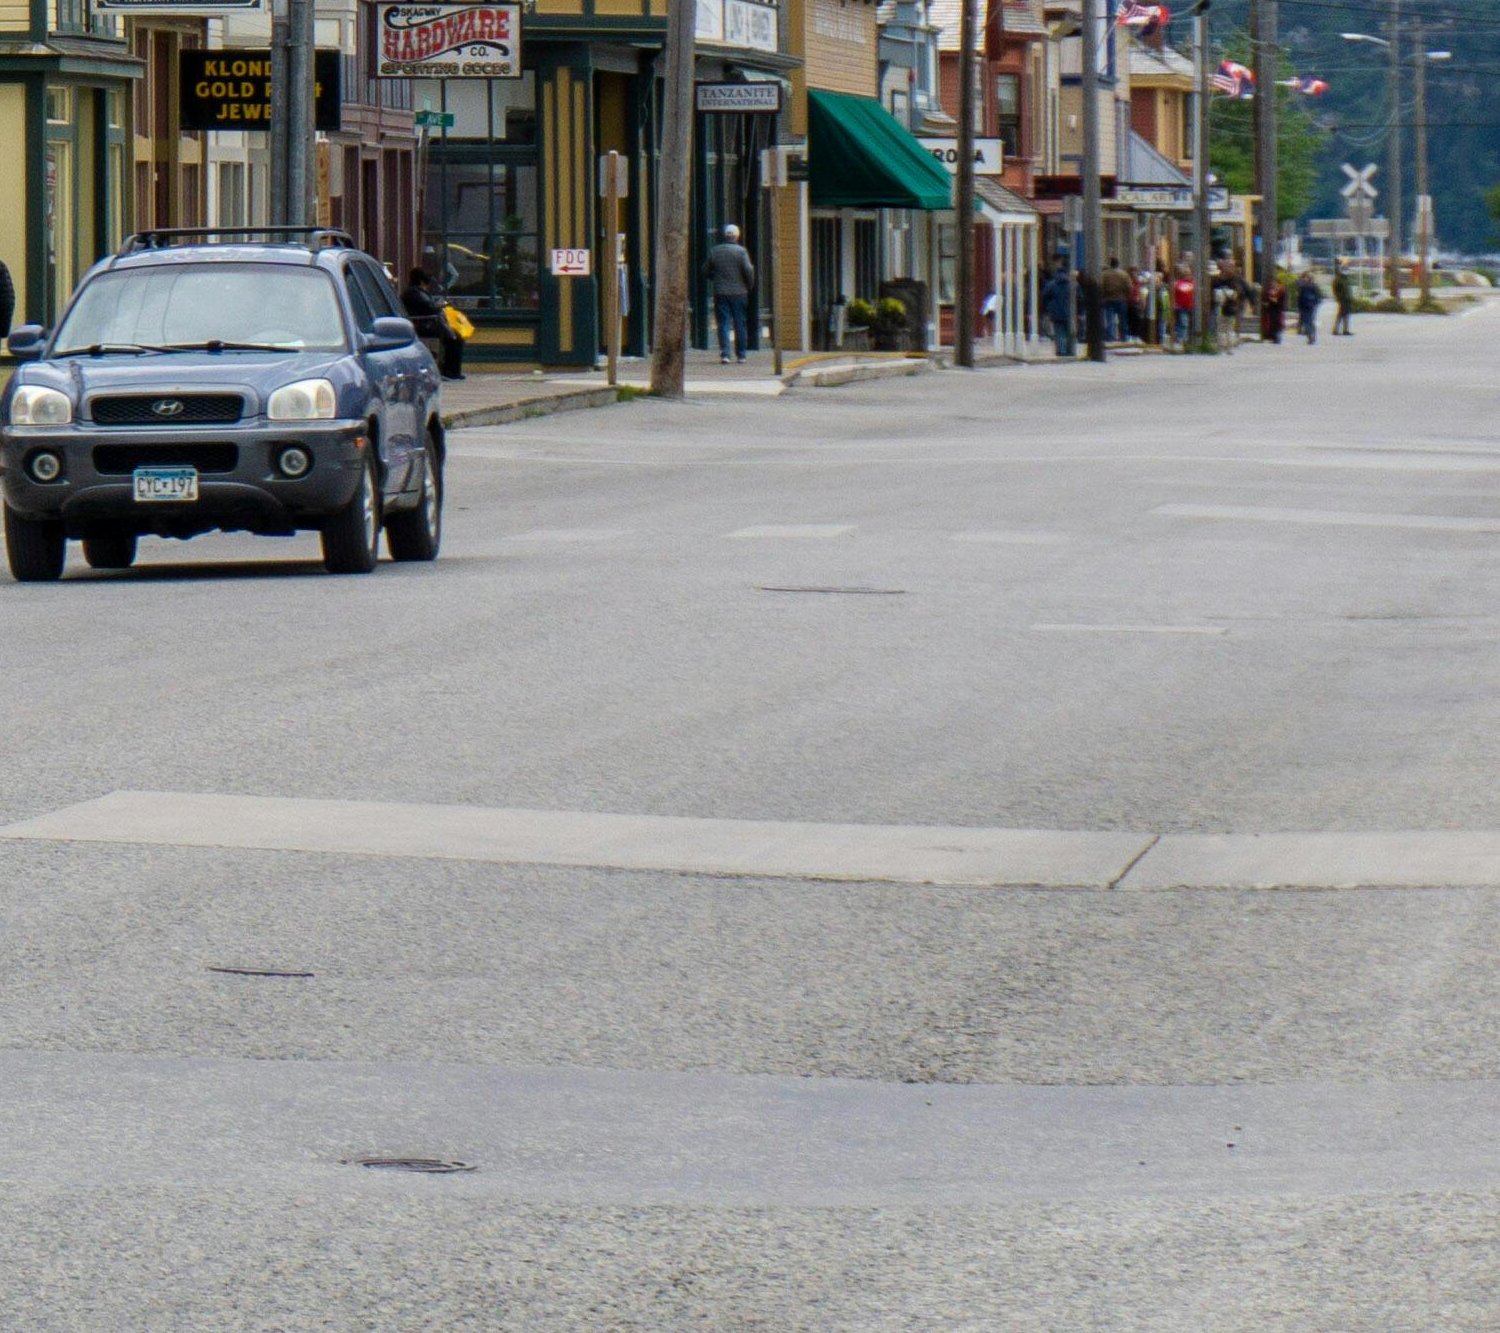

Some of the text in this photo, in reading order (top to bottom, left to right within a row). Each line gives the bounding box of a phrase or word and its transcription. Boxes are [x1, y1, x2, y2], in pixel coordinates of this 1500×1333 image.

[383, 9, 510, 60] HARDWARE
[469, 46, 490, 57] CO.
[205, 60, 272, 77] KLOND
[195, 82, 255, 98] GOLD
[700, 87, 775, 98] TANZANITE
[428, 114, 444, 125] AVE
